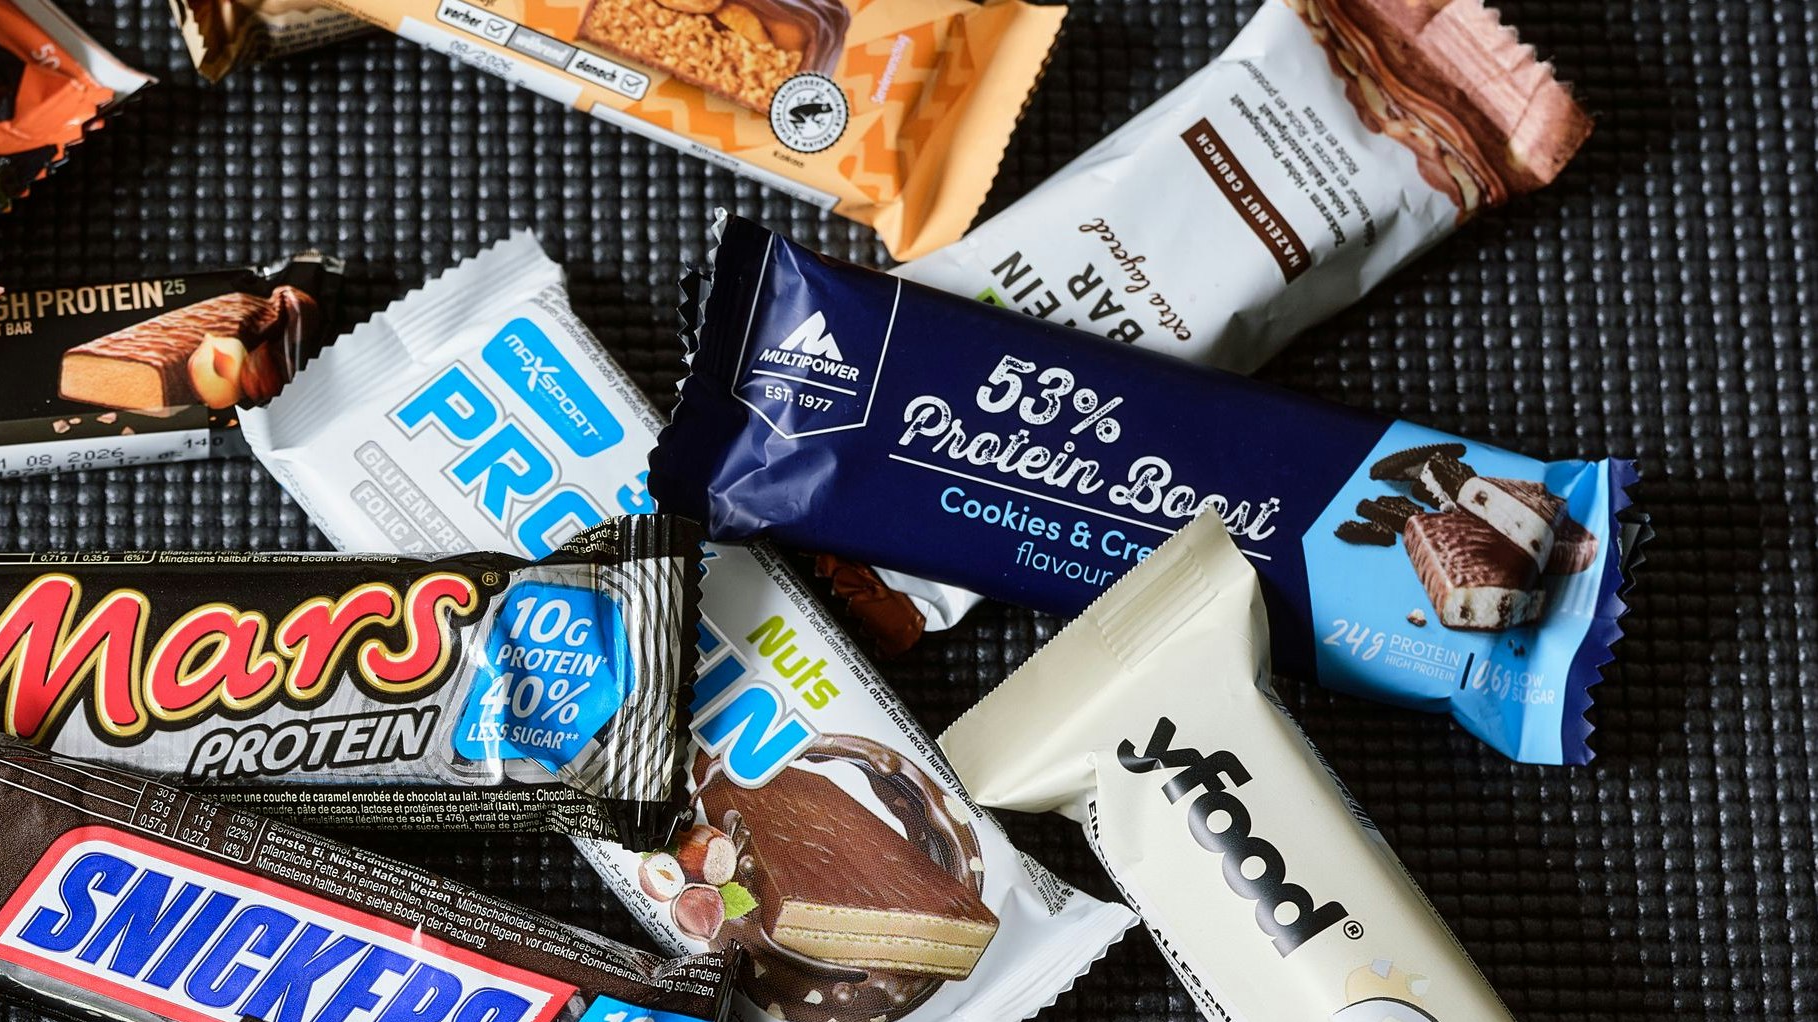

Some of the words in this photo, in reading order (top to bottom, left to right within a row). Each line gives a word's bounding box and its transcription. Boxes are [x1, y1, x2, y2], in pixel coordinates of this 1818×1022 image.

[442, 3, 483, 30] vorher
[574, 56, 619, 84] danach
[1279, 154, 1307, 190] Hoher
[1320, 183, 1351, 218] Hoher
[1239, 190, 1303, 268] HAZELNUT
[5, 322, 32, 335] BAR
[1142, 289, 1193, 346] extra
[759, 348, 859, 381] MULTIPOWER
[764, 384, 794, 401] EST.
[797, 393, 833, 412] 1977
[974, 354, 1124, 445] 53%
[67, 446, 124, 462] 2026
[898, 391, 1108, 497] Protein
[356, 486, 411, 540] FOLIC
[939, 484, 1063, 542] Cookies
[160, 555, 227, 563] Mindestens
[229, 555, 256, 563] haltbar
[744, 612, 846, 713] Nuts
[1389, 634, 1461, 666] PROTEIN
[1384, 655, 1412, 669] HIGH
[1414, 664, 1455, 683] PROTEIN
[1512, 670, 1544, 689] LOW
[867, 685, 891, 710] otros
[1511, 686, 1555, 706] SUGAR
[138, 814, 158, 832] 0,57
[265, 831, 309, 855] Gerste,
[328, 852, 369, 876] Nüsse,
[255, 856, 312, 886] Mindestens
[312, 876, 346, 898] haltbar
[258, 842, 311, 872] pflanzliche
[389, 886, 424, 909] kühlen,
